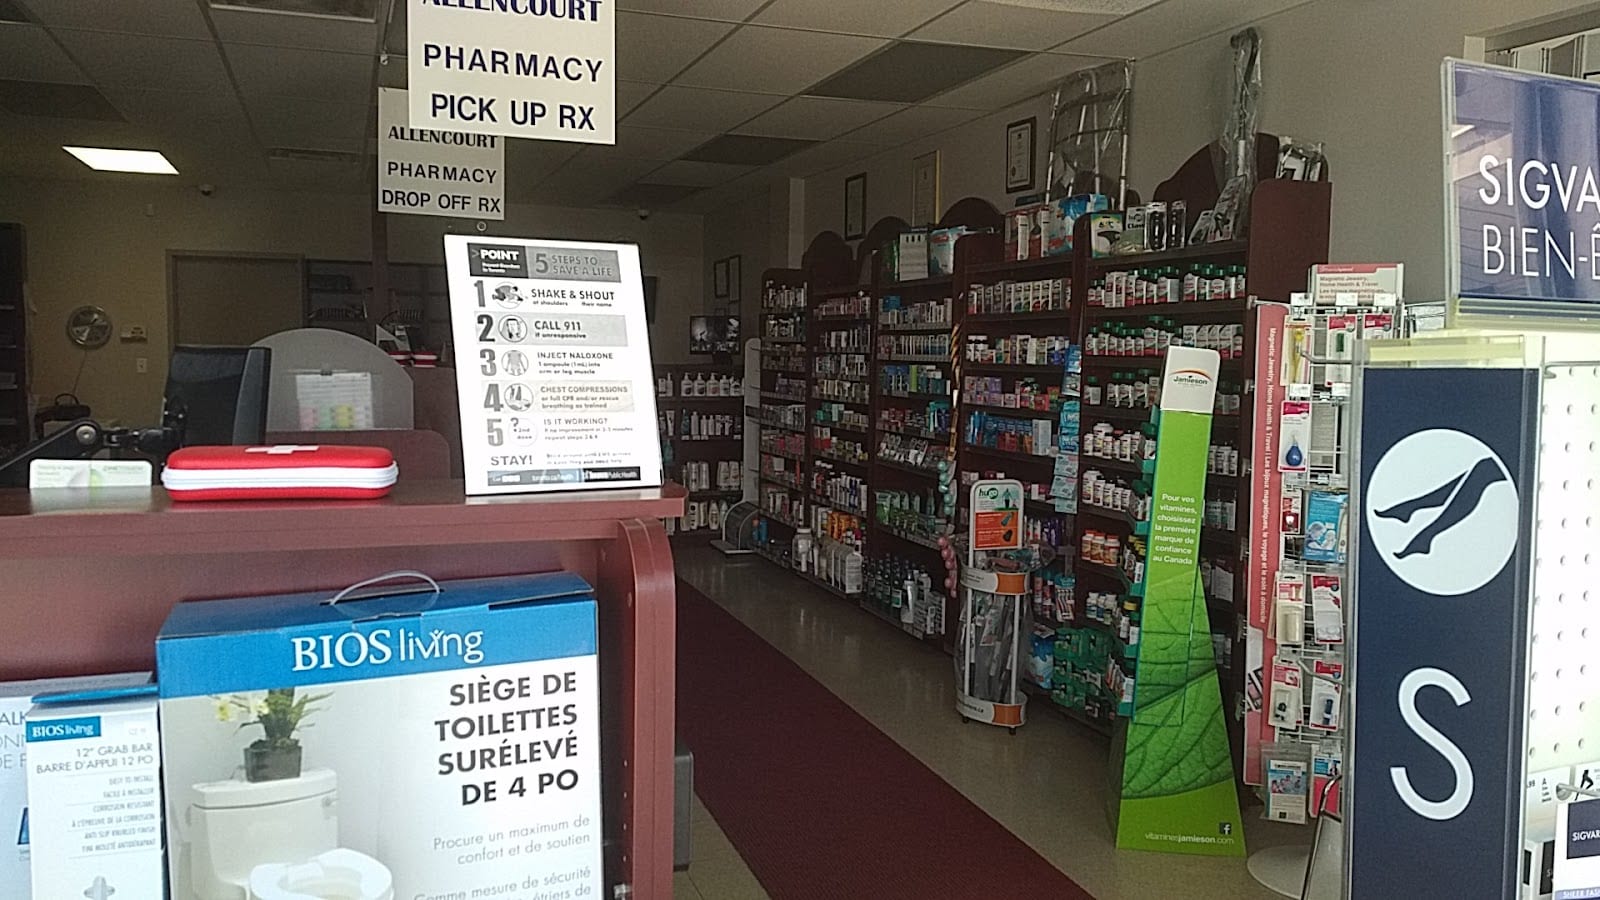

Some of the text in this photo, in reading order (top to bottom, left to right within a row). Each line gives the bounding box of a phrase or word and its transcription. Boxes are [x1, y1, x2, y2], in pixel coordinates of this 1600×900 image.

[424, 44, 603, 82] PHARMACY
[431, 93, 595, 130] PICK UP RX
[388, 126, 497, 148] ALLENCOURT
[387, 161, 497, 184] PHARMACY
[1479, 155, 1600, 213] SIGVA
[382, 190, 501, 213] DROP OFF RX
[480, 249, 519, 261] POINT
[535, 253, 549, 273] 5
[552, 255, 597, 265] STEPS TO
[553, 265, 612, 276] SAVE A LIFE
[474, 280, 486, 307] 1
[531, 288, 614, 300] SHAKE & SHOUT
[477, 314, 496, 342] 2
[534, 320, 581, 330] CALL 911
[1267, 328, 1277, 357] Magnetic
[480, 348, 497, 376] 3
[1266, 357, 1276, 384] Jewelry,
[1173, 376, 1208, 384] Jamieson
[484, 384, 504, 412] 4
[1266, 385, 1275, 404] Home
[565, 417, 608, 425] WORKING?
[1265, 404, 1274, 425] Health
[486, 418, 504, 446] 5
[1264, 432, 1273, 452] Travel
[491, 455, 533, 466] STAY!
[1263, 456, 1272, 468] Les
[1262, 468, 1272, 488] bijoux
[1162, 493, 1179, 501] Pour
[1157, 514, 1196, 523] choisissez
[1160, 505, 1197, 514] vitamines,
[1155, 535, 1183, 544] marque
[1163, 525, 1196, 534] première
[1155, 545, 1192, 554] confiance
[1259, 539, 1269, 561] voyage
[1164, 555, 1193, 565] Canada
[1259, 576, 1268, 590] soin
[292, 627, 485, 671] BIOS living
[450, 671, 576, 706] SIÈGE DE
[32, 725, 64, 737] BIOS
[434, 704, 577, 742] TOILETTES
[98, 744, 128, 756] GRAB
[132, 742, 152, 753] BAR
[438, 730, 578, 776] SURÉLEVÉ
[1390, 667, 1475, 820] S
[36, 762, 72, 774] BARRE
[121, 756, 134, 766] 12
[137, 755, 153, 764] PO
[462, 769, 578, 806] DE 4 PO
[433, 814, 590, 850] Procure un maximum de
[457, 833, 590, 864] confort et de soutien
[471, 882, 517, 898] mesure
[522, 876, 539, 889] de
[544, 866, 591, 886] sécurité
[574, 885, 591, 897] de
